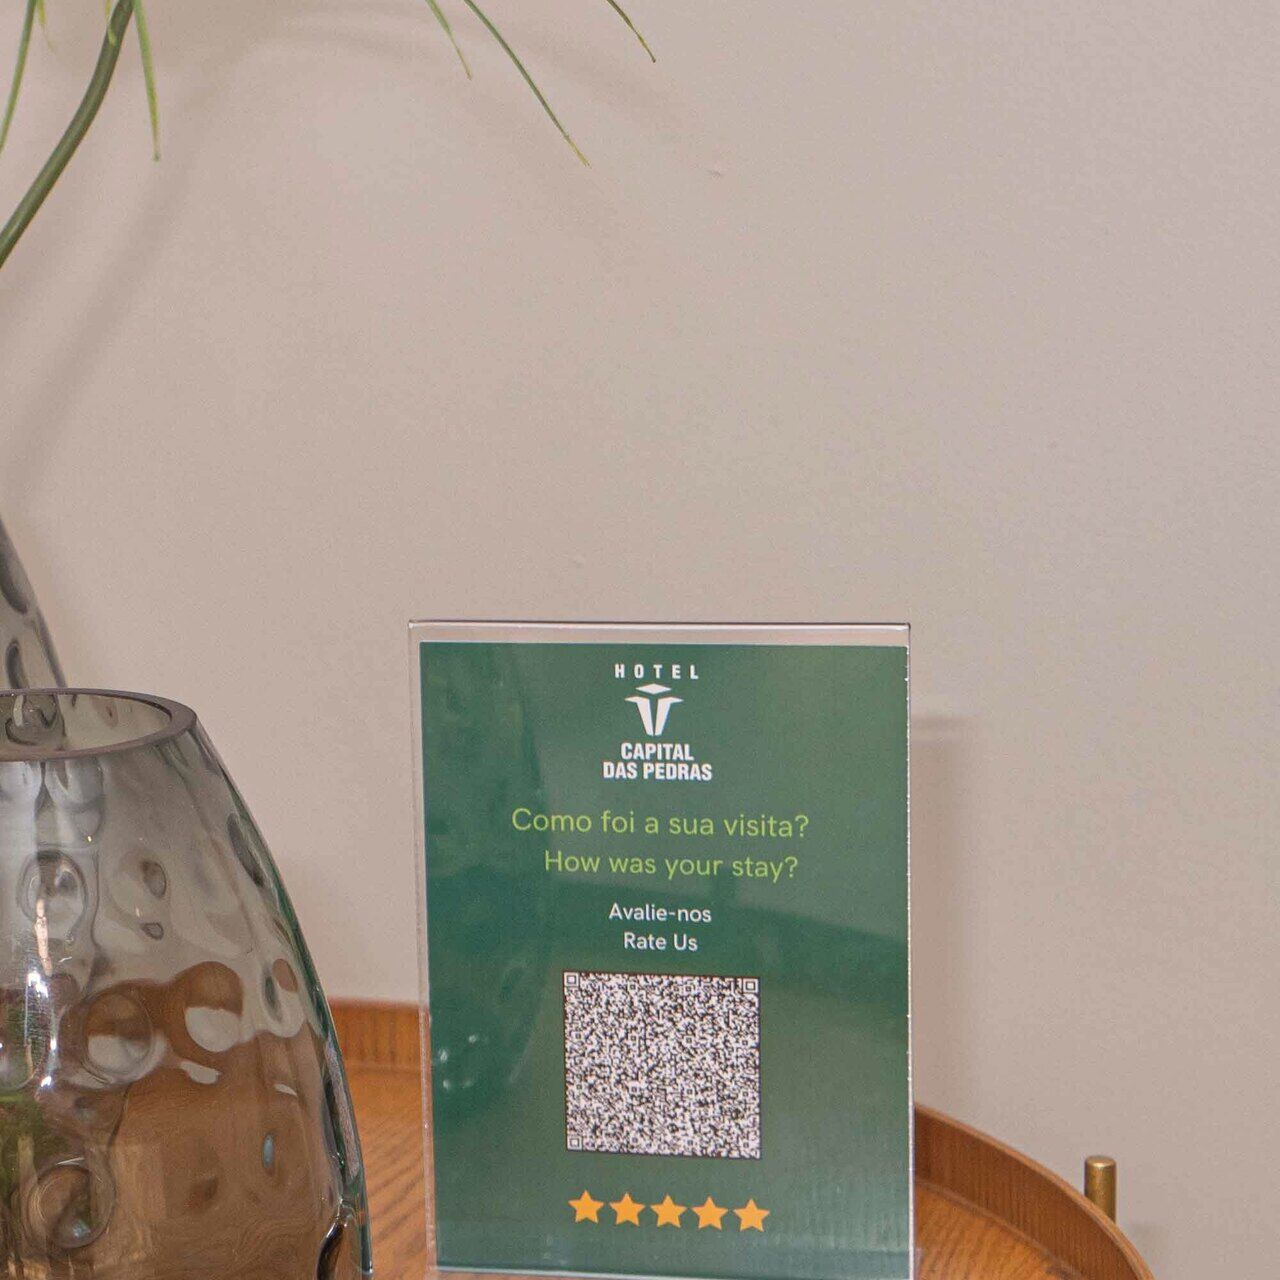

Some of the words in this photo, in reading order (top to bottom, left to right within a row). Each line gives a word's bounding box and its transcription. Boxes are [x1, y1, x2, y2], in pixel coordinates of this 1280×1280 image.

[614, 663, 699, 680] HOTEL
[620, 742, 694, 761] CAPITAL
[602, 761, 638, 779] DAS
[643, 762, 713, 781] PEDRAS
[511, 808, 592, 833] Como
[600, 809, 635, 833] foi
[644, 818, 659, 834] a
[669, 816, 714, 835] sua
[723, 813, 810, 838] visita?
[544, 850, 600, 873] How
[608, 857, 656, 874] was
[664, 857, 722, 880] your
[731, 857, 799, 883] stay?
[608, 903, 712, 923] Avalie-nos
[623, 931, 667, 951] Rate
[673, 933, 698, 952] Us
